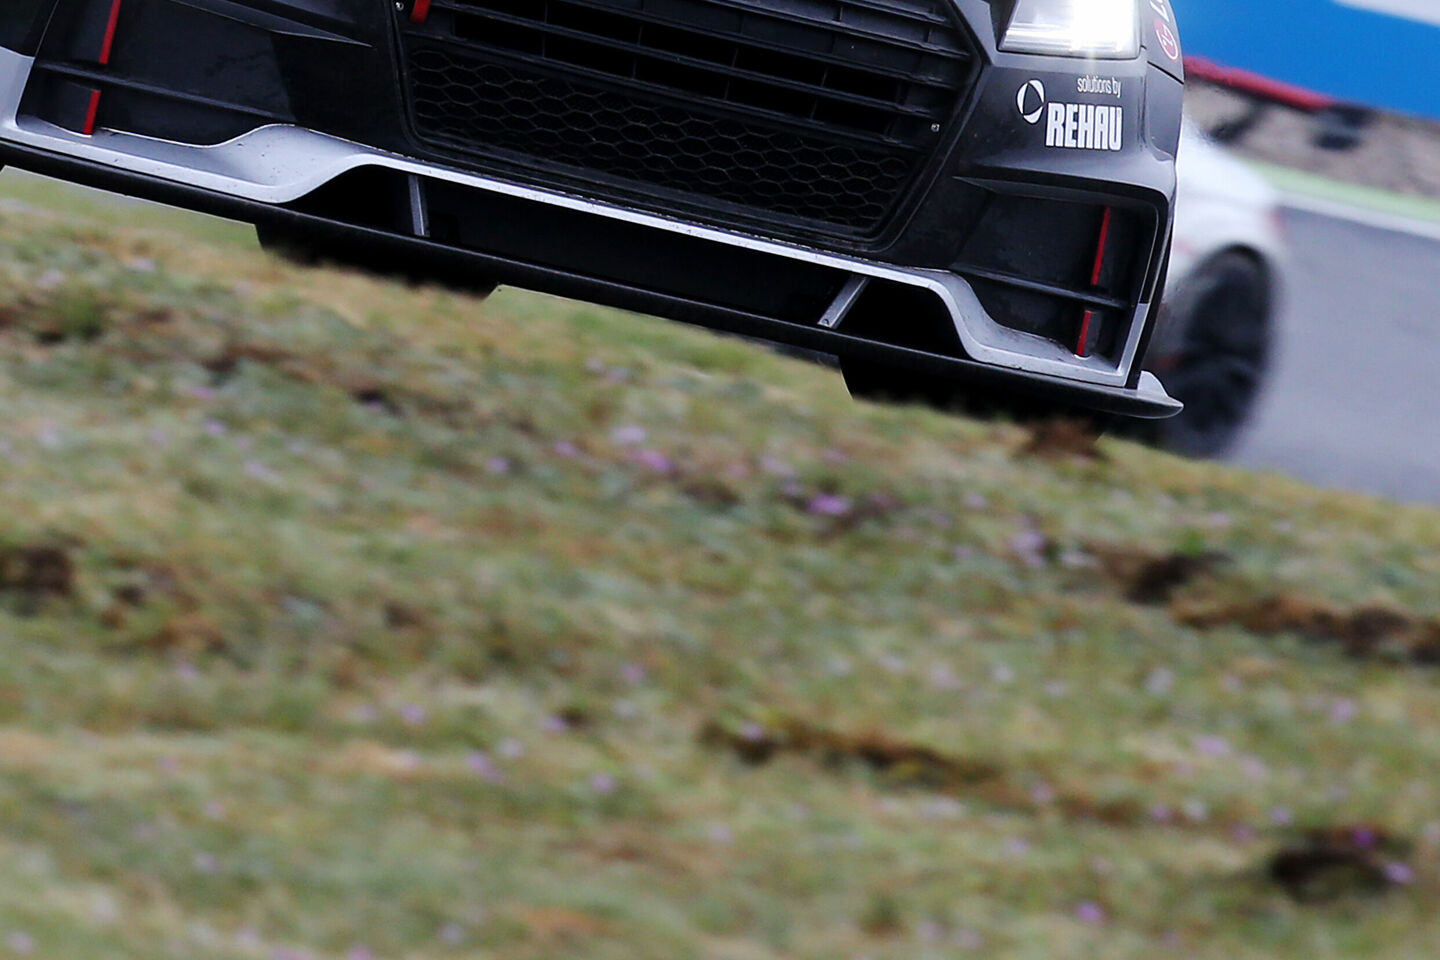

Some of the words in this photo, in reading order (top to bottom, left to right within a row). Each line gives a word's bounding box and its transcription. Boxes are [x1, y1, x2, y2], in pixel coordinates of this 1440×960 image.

[1077, 75, 1112, 94] solutions
[1112, 77, 1122, 98] by
[1045, 102, 1123, 151] REHAU
